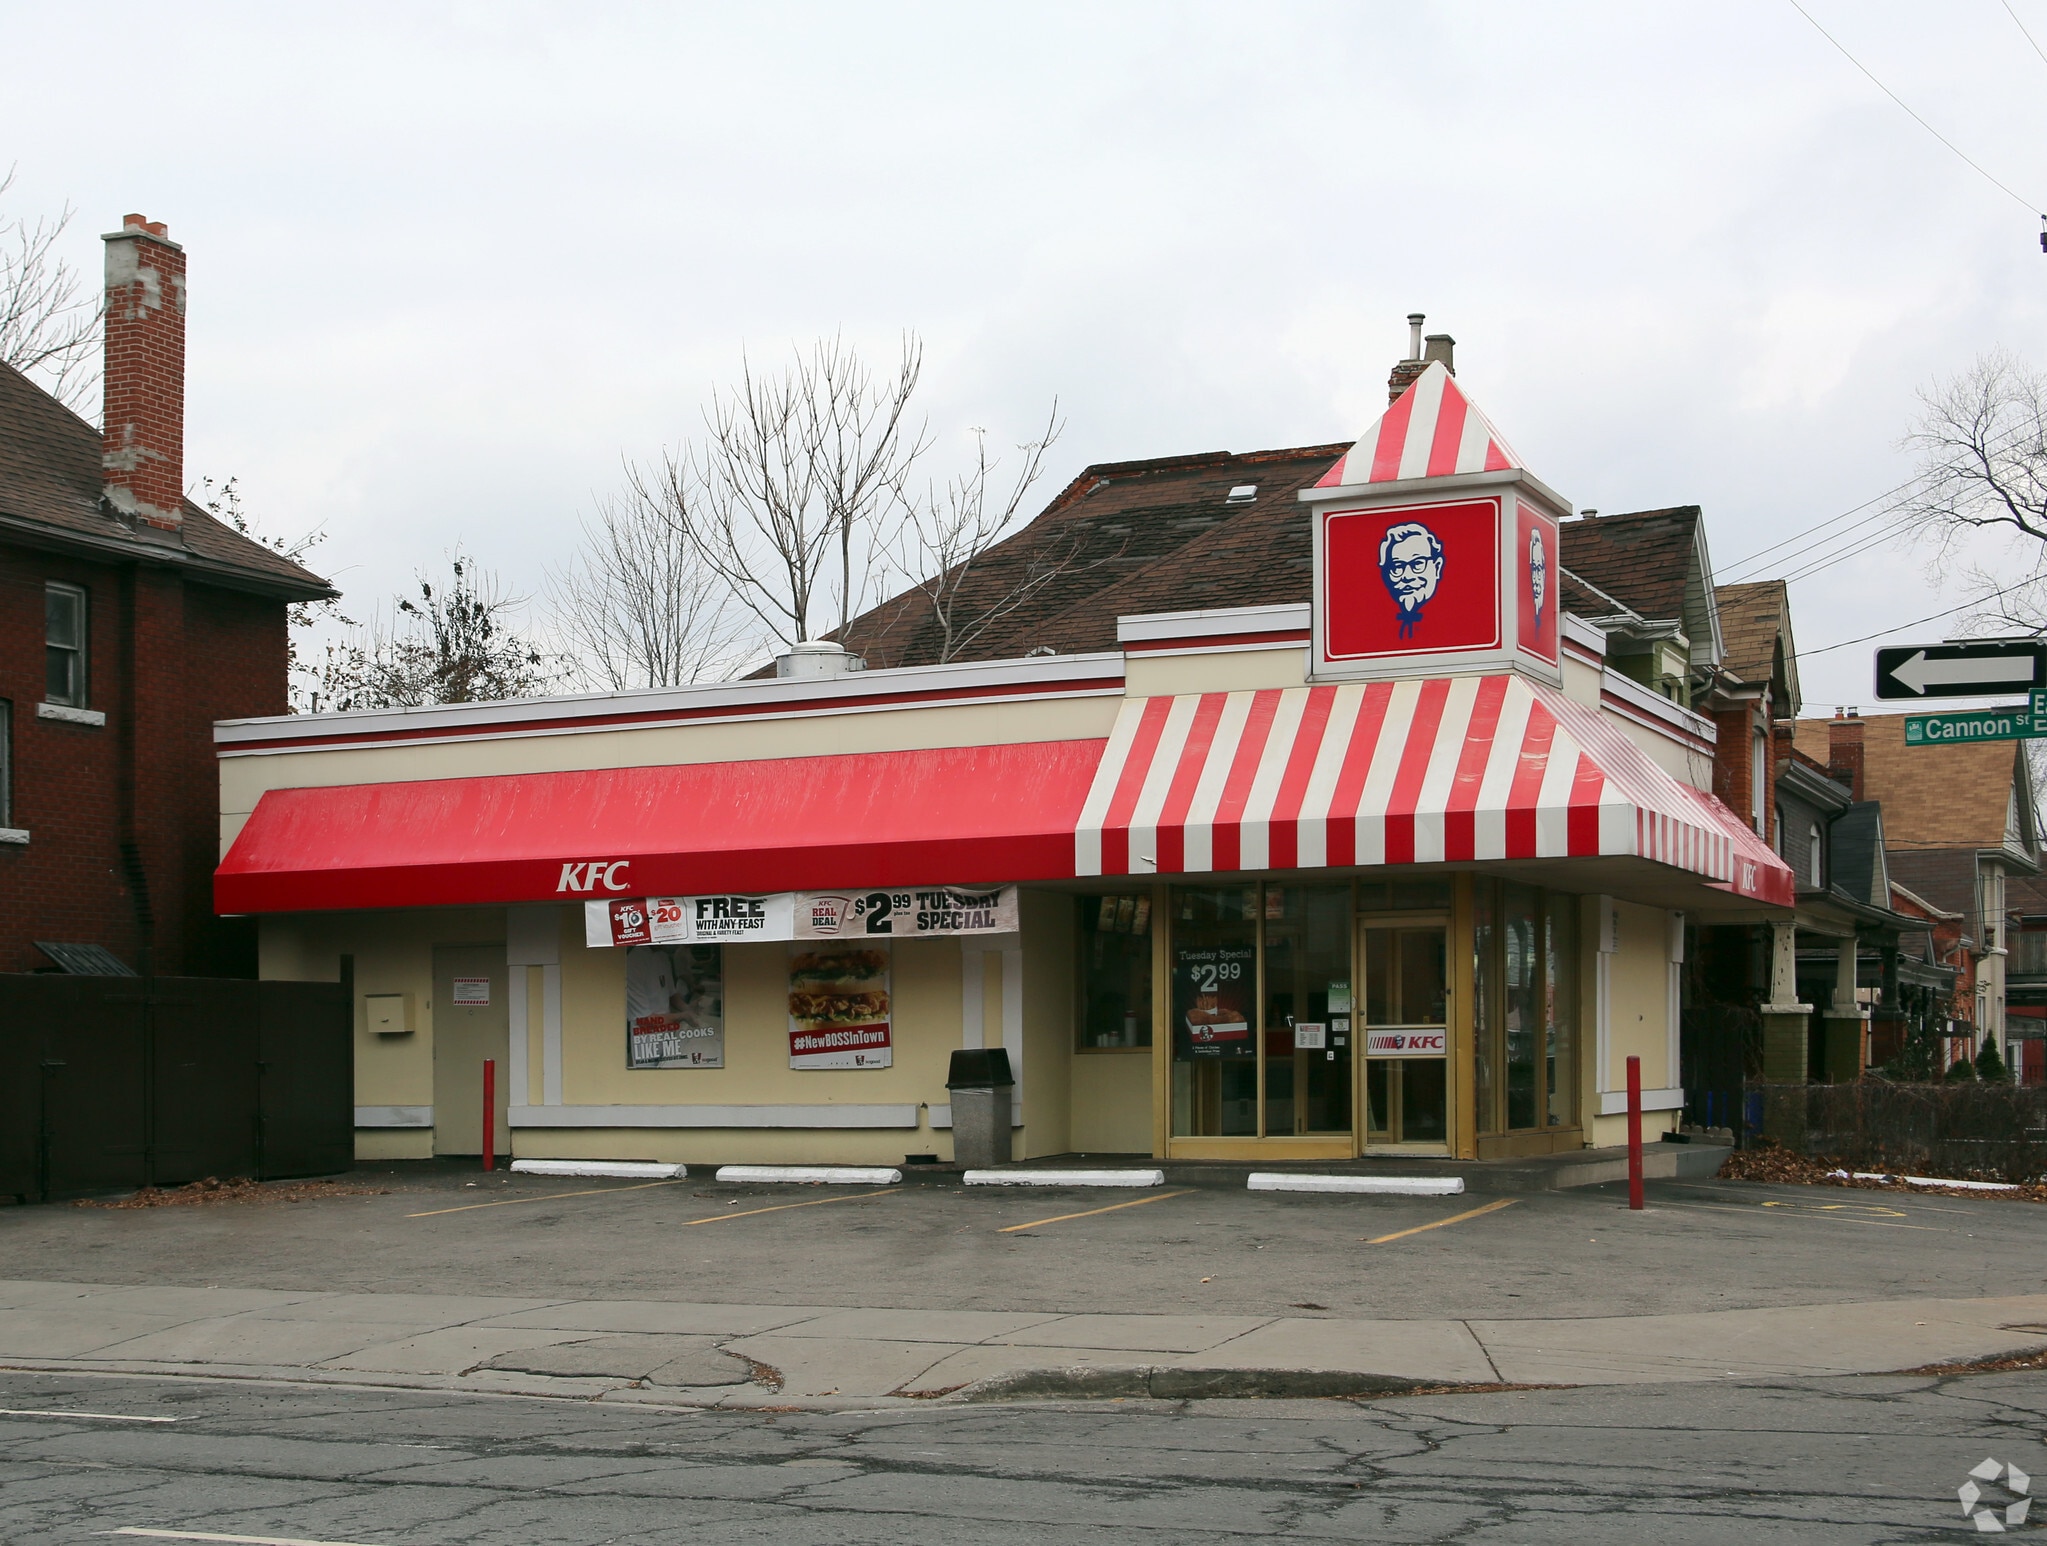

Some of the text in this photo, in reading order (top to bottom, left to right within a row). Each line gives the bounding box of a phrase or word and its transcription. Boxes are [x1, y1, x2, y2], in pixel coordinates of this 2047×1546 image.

[1925, 718, 2011, 739] Cannon
[2016, 714, 2030, 726] St
[555, 860, 630, 892] KFC
[1742, 862, 1757, 892] KFC
[695, 897, 766, 919] FREE
[915, 890, 1001, 910] TUESDAY
[620, 905, 634, 913] KFC
[651, 906, 682, 923] $20
[812, 908, 837, 917] REAL
[696, 918, 765, 930] WITH ANY FEAST
[812, 917, 837, 926] DEAL
[916, 910, 996, 930] SPECIAL
[617, 931, 645, 940] VOUCHER
[1179, 949, 1251, 960] Tuesday Special
[636, 1016, 665, 1025] HAND
[633, 1023, 680, 1036] BREADED
[633, 1027, 715, 1044] BY REAL COOKS
[794, 1030, 885, 1050] #NewBOSSInTown
[1408, 1035, 1444, 1049] KFC
[634, 1042, 660, 1060] LIKE
[662, 1040, 682, 1057] ME
